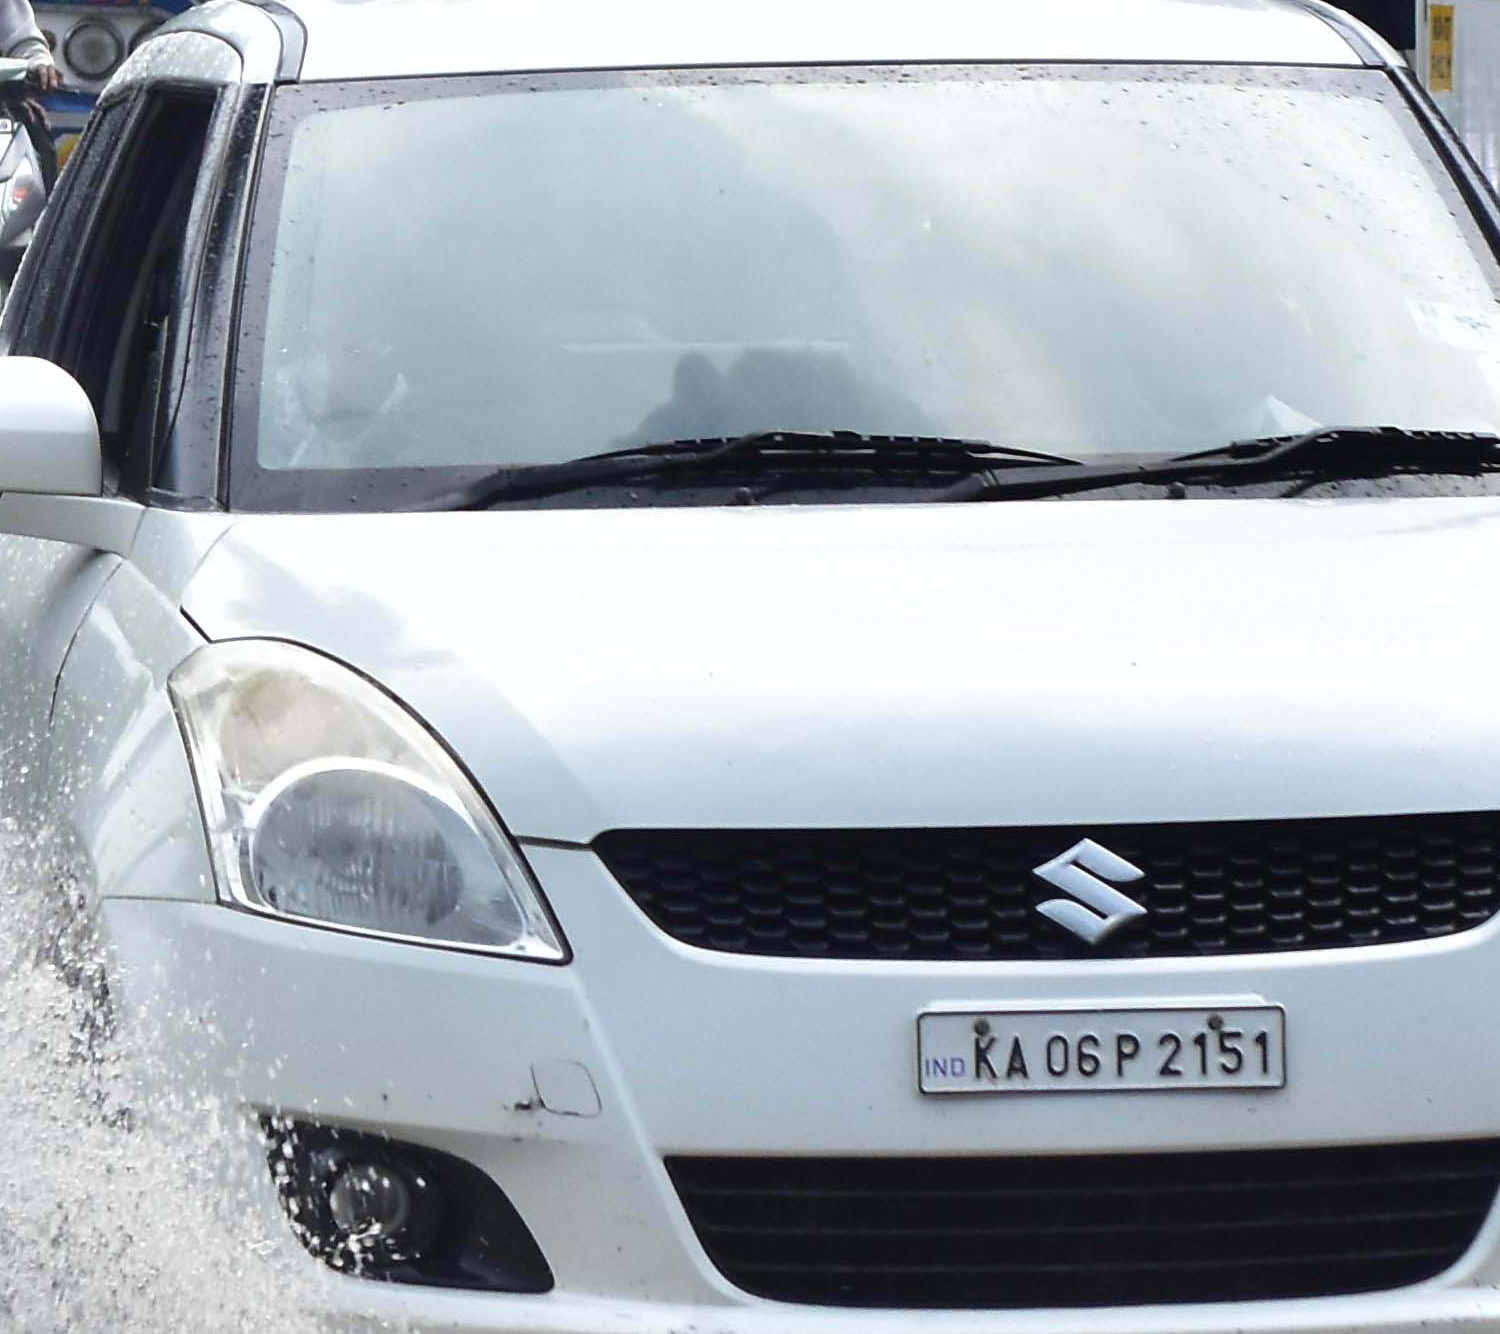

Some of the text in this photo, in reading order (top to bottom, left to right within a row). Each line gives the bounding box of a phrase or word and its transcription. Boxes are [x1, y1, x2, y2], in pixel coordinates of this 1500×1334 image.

[925, 1057, 967, 1077] IND
[973, 1033, 1030, 1080] KA
[1157, 1030, 1270, 1077] 2151
